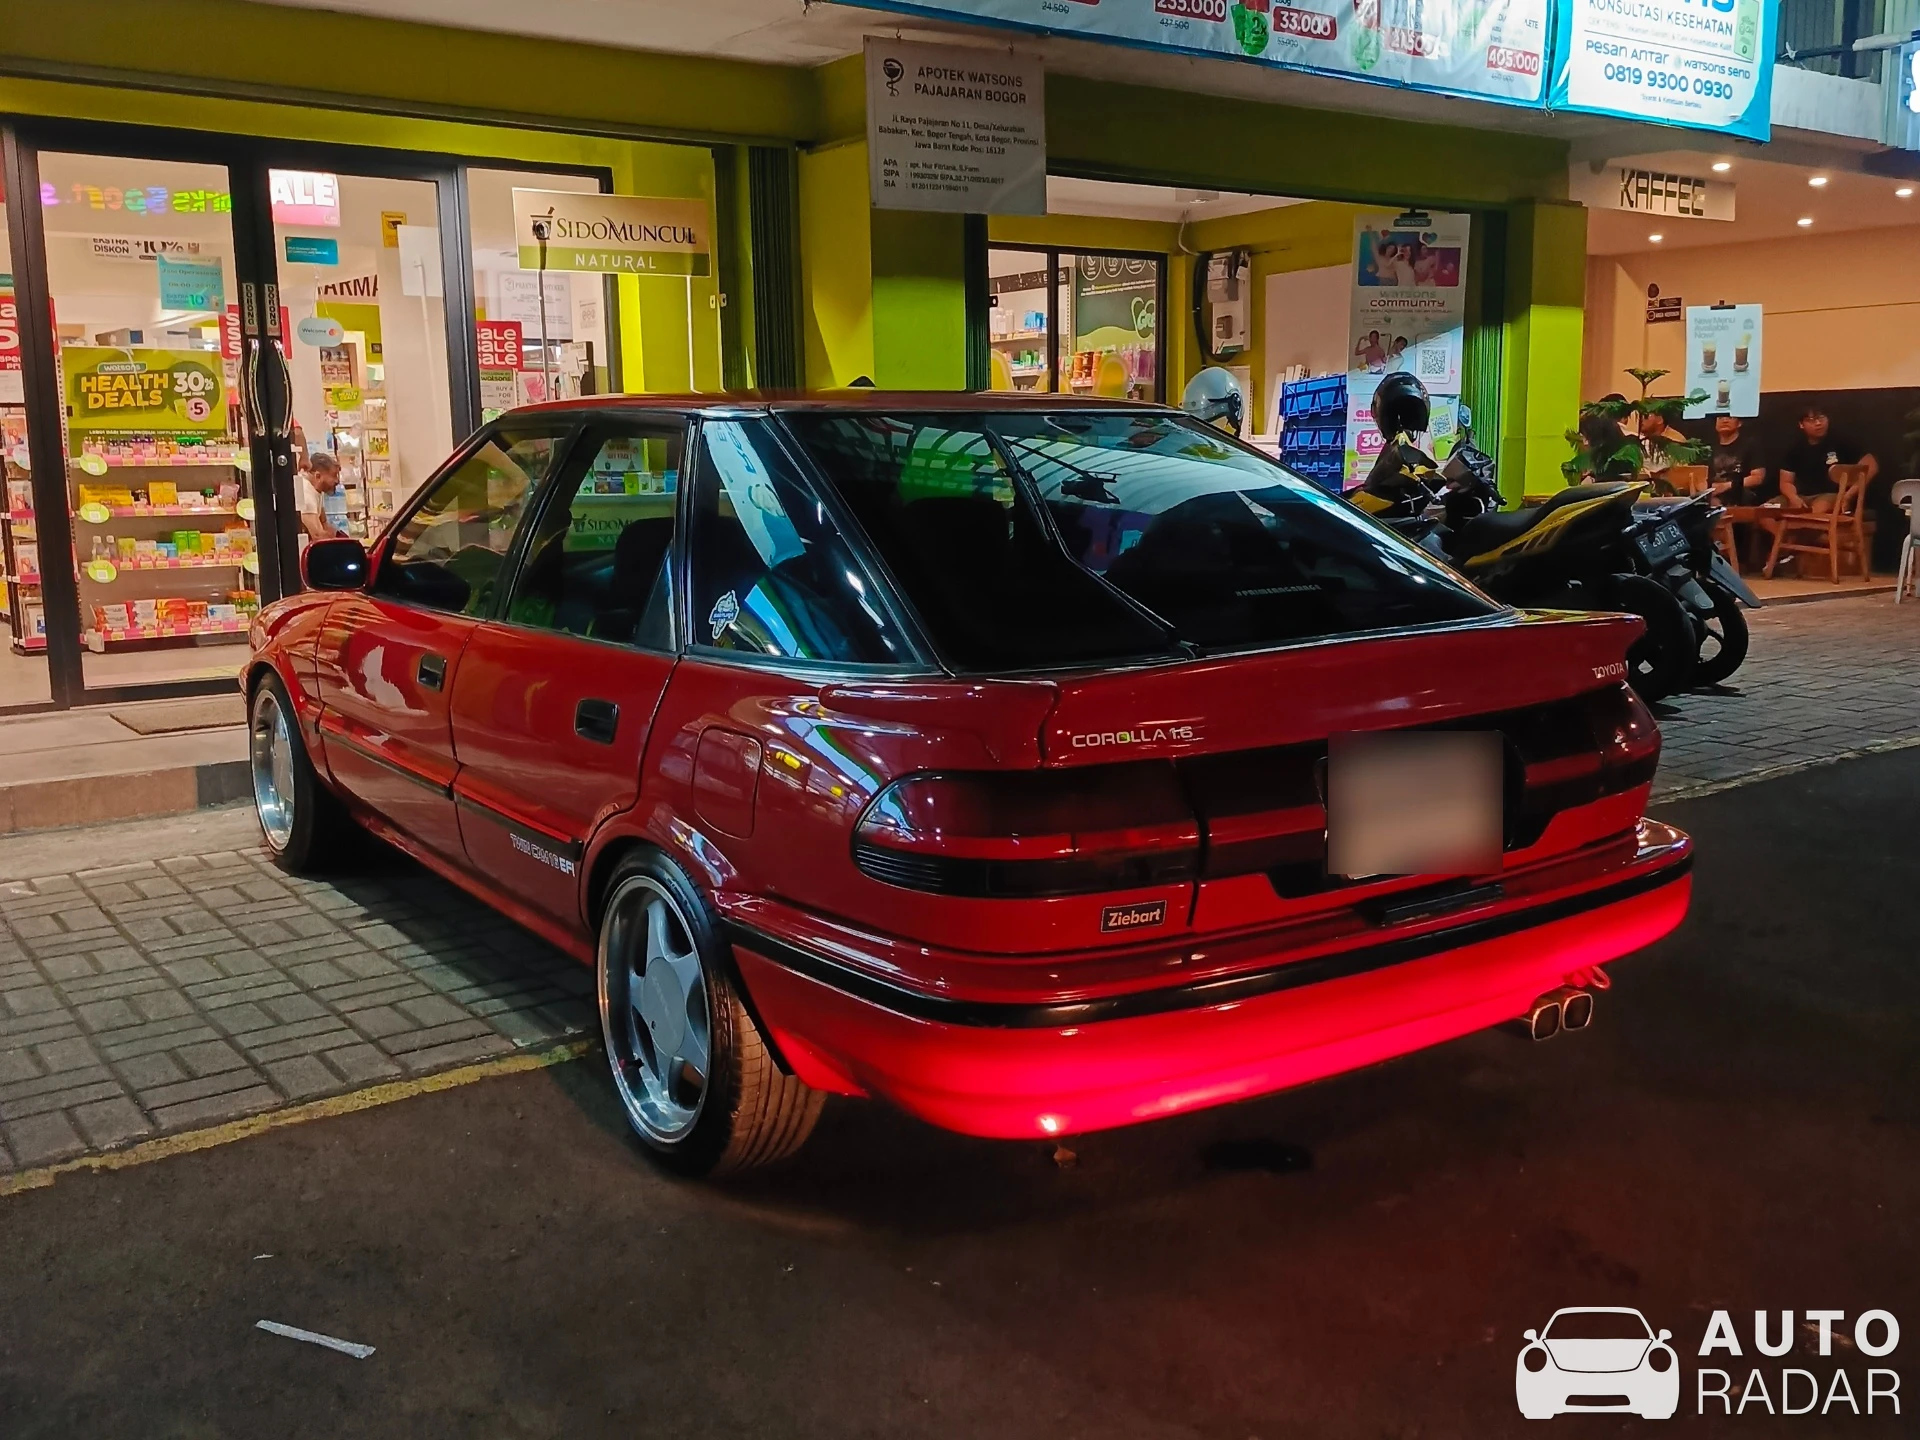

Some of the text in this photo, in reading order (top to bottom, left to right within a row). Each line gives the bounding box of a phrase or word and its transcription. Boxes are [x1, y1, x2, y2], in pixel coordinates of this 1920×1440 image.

[1280, 11, 1331, 36] 33.000
[1667, 12, 1733, 36] KESEHATAN
[1489, 48, 1538, 72] 405.000
[917, 66, 1023, 87] APOTEK WATSONS
[1604, 63, 1733, 100] 0819 9300 0930
[914, 83, 1027, 104] PAJAJARAN BOGOR
[900, 115, 917, 126] Raya
[918, 117, 949, 129] Pajajaran
[950, 120, 961, 128] No
[927, 130, 947, 140] Bogor
[975, 134, 990, 142] Kota
[914, 141, 932, 150] Jawa
[933, 143, 951, 151] Barat
[952, 144, 969, 152] Kode
[883, 158, 898, 167] APA
[884, 169, 900, 177] SIPA
[269, 175, 336, 207] ALE
[884, 180, 896, 188] SIA
[94, 244, 130, 254] DISKON
[575, 253, 657, 272] NATURAL
[245, 284, 256, 326] DORONG
[267, 285, 277, 326] DORONG
[81, 372, 169, 393] HEALTH
[88, 390, 163, 409] DEALS
[1592, 662, 1625, 679] TOYOTA
[1072, 726, 1194, 748] COROLLA 1.6
[1108, 908, 1161, 927] Ziebart
